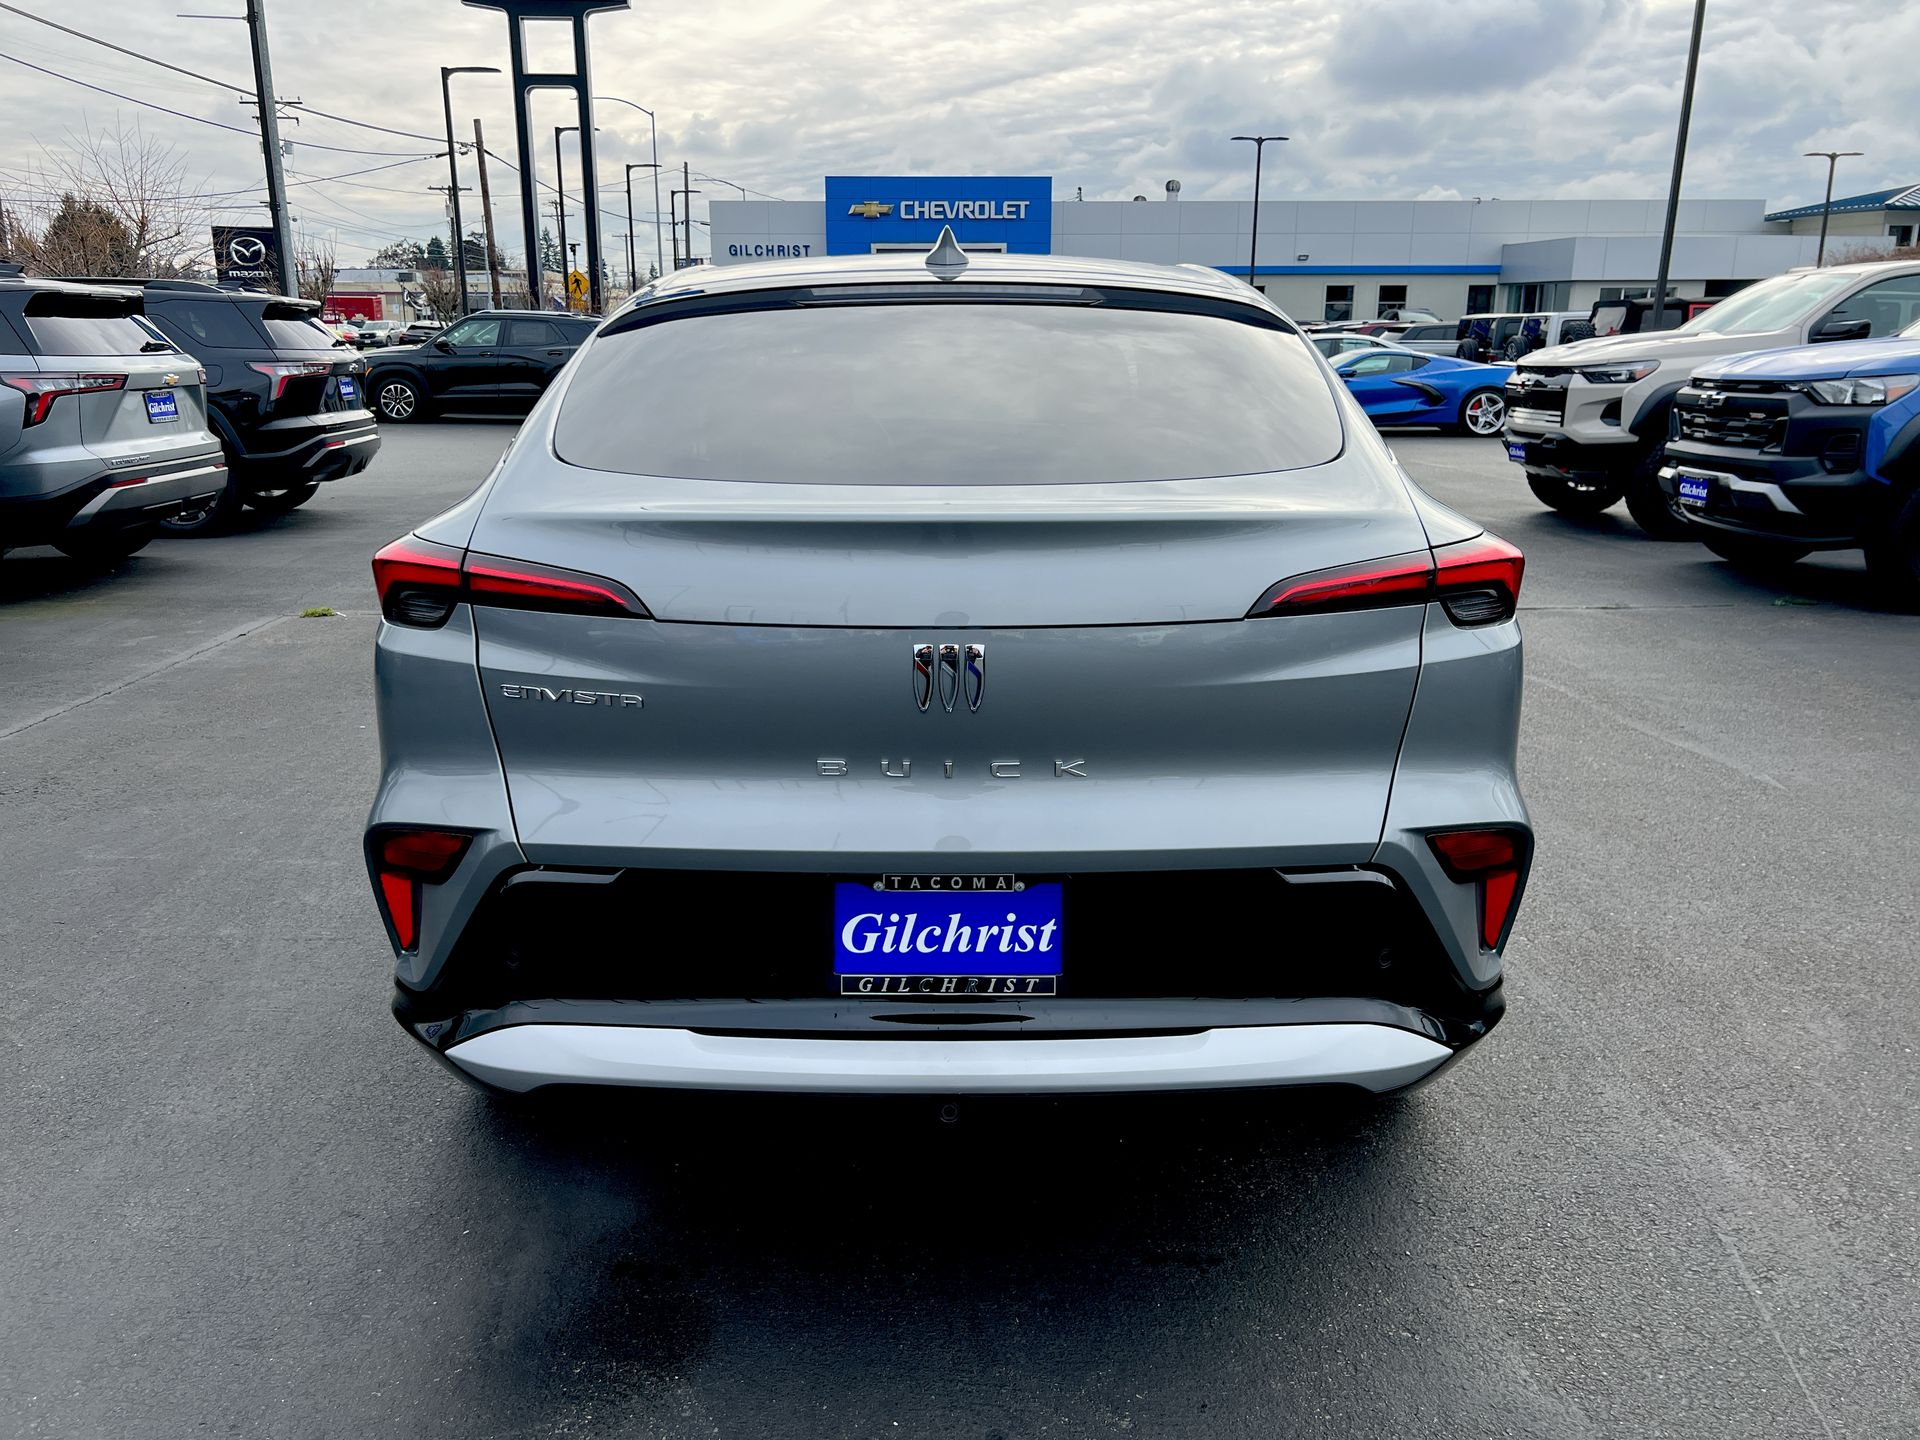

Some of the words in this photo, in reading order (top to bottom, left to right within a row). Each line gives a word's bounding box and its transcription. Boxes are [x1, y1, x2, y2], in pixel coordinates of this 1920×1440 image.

[900, 200, 1030, 219] CHEVROLET
[728, 244, 811, 257] GILCHRIST
[149, 402, 175, 413] Gilchrist
[1680, 482, 1707, 497] Gilchrist
[500, 684, 644, 708] ENVISTA
[816, 758, 1087, 778] BUICK
[891, 876, 1007, 889] TACOMA
[841, 912, 1057, 954] Gilchrist
[858, 977, 1039, 993] GILCHRIST
